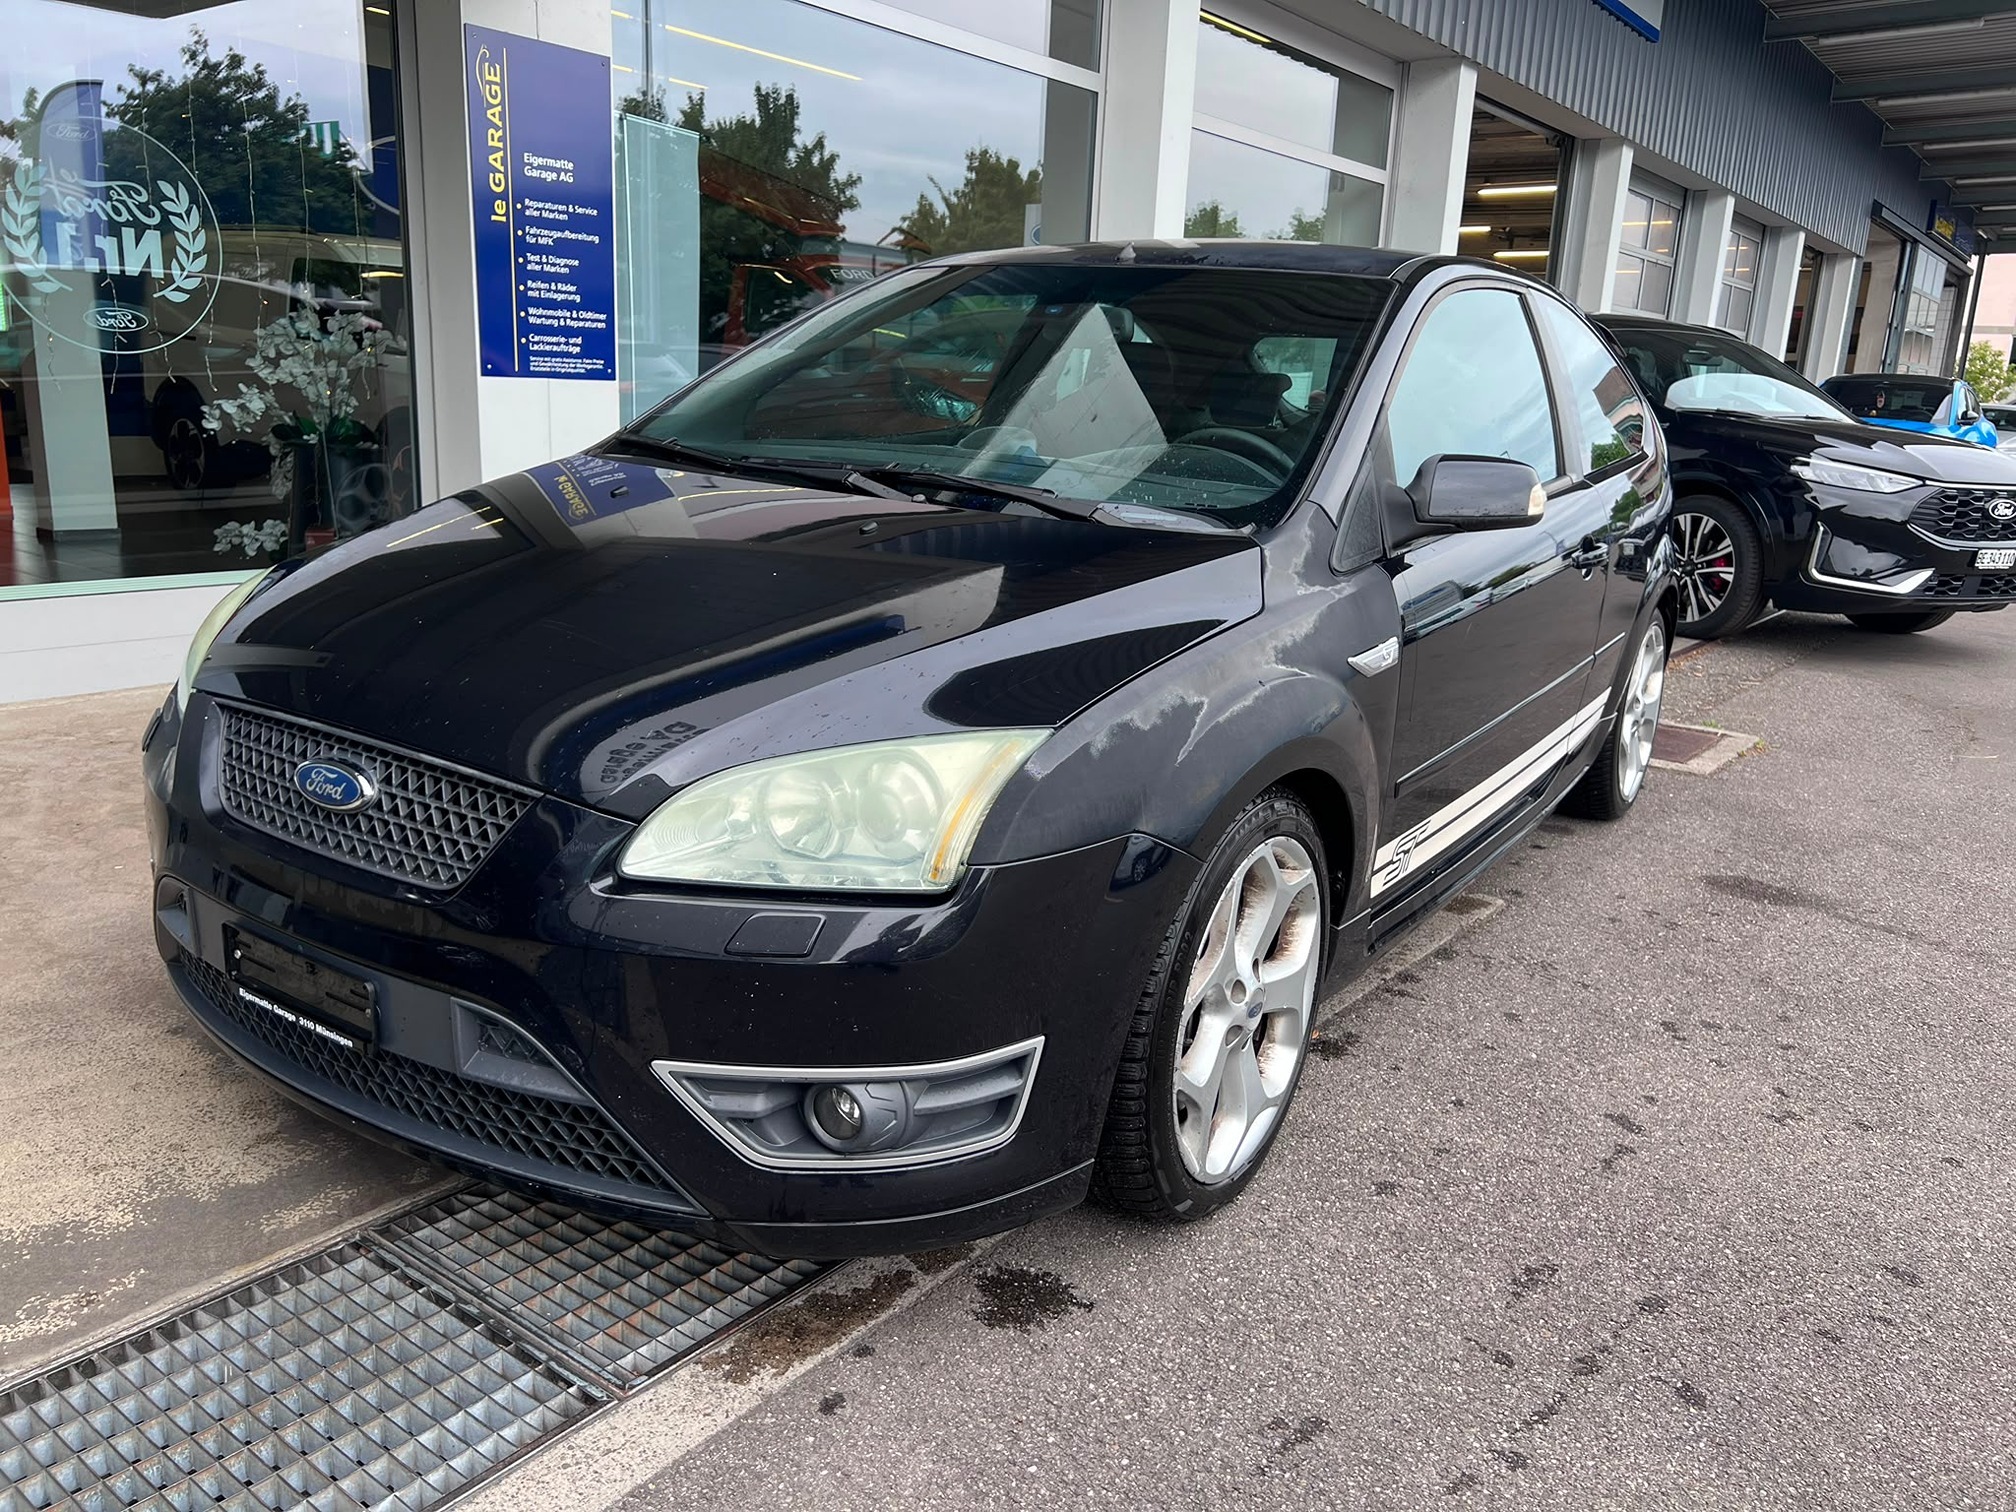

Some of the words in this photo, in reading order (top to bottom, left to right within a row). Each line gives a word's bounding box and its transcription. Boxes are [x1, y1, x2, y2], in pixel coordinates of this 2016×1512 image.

[485, 62, 506, 192] GARAGE
[524, 152, 574, 170] Eigermatte
[524, 165, 558, 182] Garage
[559, 171, 574, 183] AG
[491, 199, 507, 222] le
[524, 198, 567, 212] Reparaturen
[568, 204, 574, 212] &
[575, 205, 598, 216] Service
[525, 208, 540, 217] aller
[541, 210, 568, 220] Marken
[525, 225, 600, 244] Fahrzeugaufbereitung
[526, 235, 537, 243] für
[538, 236, 554, 245] MFK
[526, 253, 541, 262] Test
[541, 254, 547, 262] &
[548, 255, 580, 266] Diagnose
[526, 262, 541, 271] aller
[543, 264, 570, 274] Marken
[830, 268, 875, 280] FORD
[527, 280, 549, 290] Reifen
[550, 282, 556, 290] &
[557, 282, 577, 292] Räder
[527, 289, 539, 298] mit
[540, 290, 581, 303] Einlagerung
[527, 307, 571, 318] Wohnmobile
[572, 310, 578, 318] &
[578, 311, 607, 320] Oldtimer
[527, 316, 558, 327] Wartung
[559, 318, 565, 326] &
[566, 318, 606, 329] Reparaturen
[528, 333, 568, 344] Carrosserie-
[568, 336, 582, 344] und
[529, 343, 581, 354] Lackieraufträge
[1993, 502, 2015, 517] Ford
[305, 767, 348, 800] Ford
[1382, 819, 1432, 887] ST
[239, 987, 273, 1011] Eigermatte
[273, 1004, 297, 1022] Garage
[299, 1016, 315, 1030] 3110
[315, 1023, 353, 1048] Münsingen
